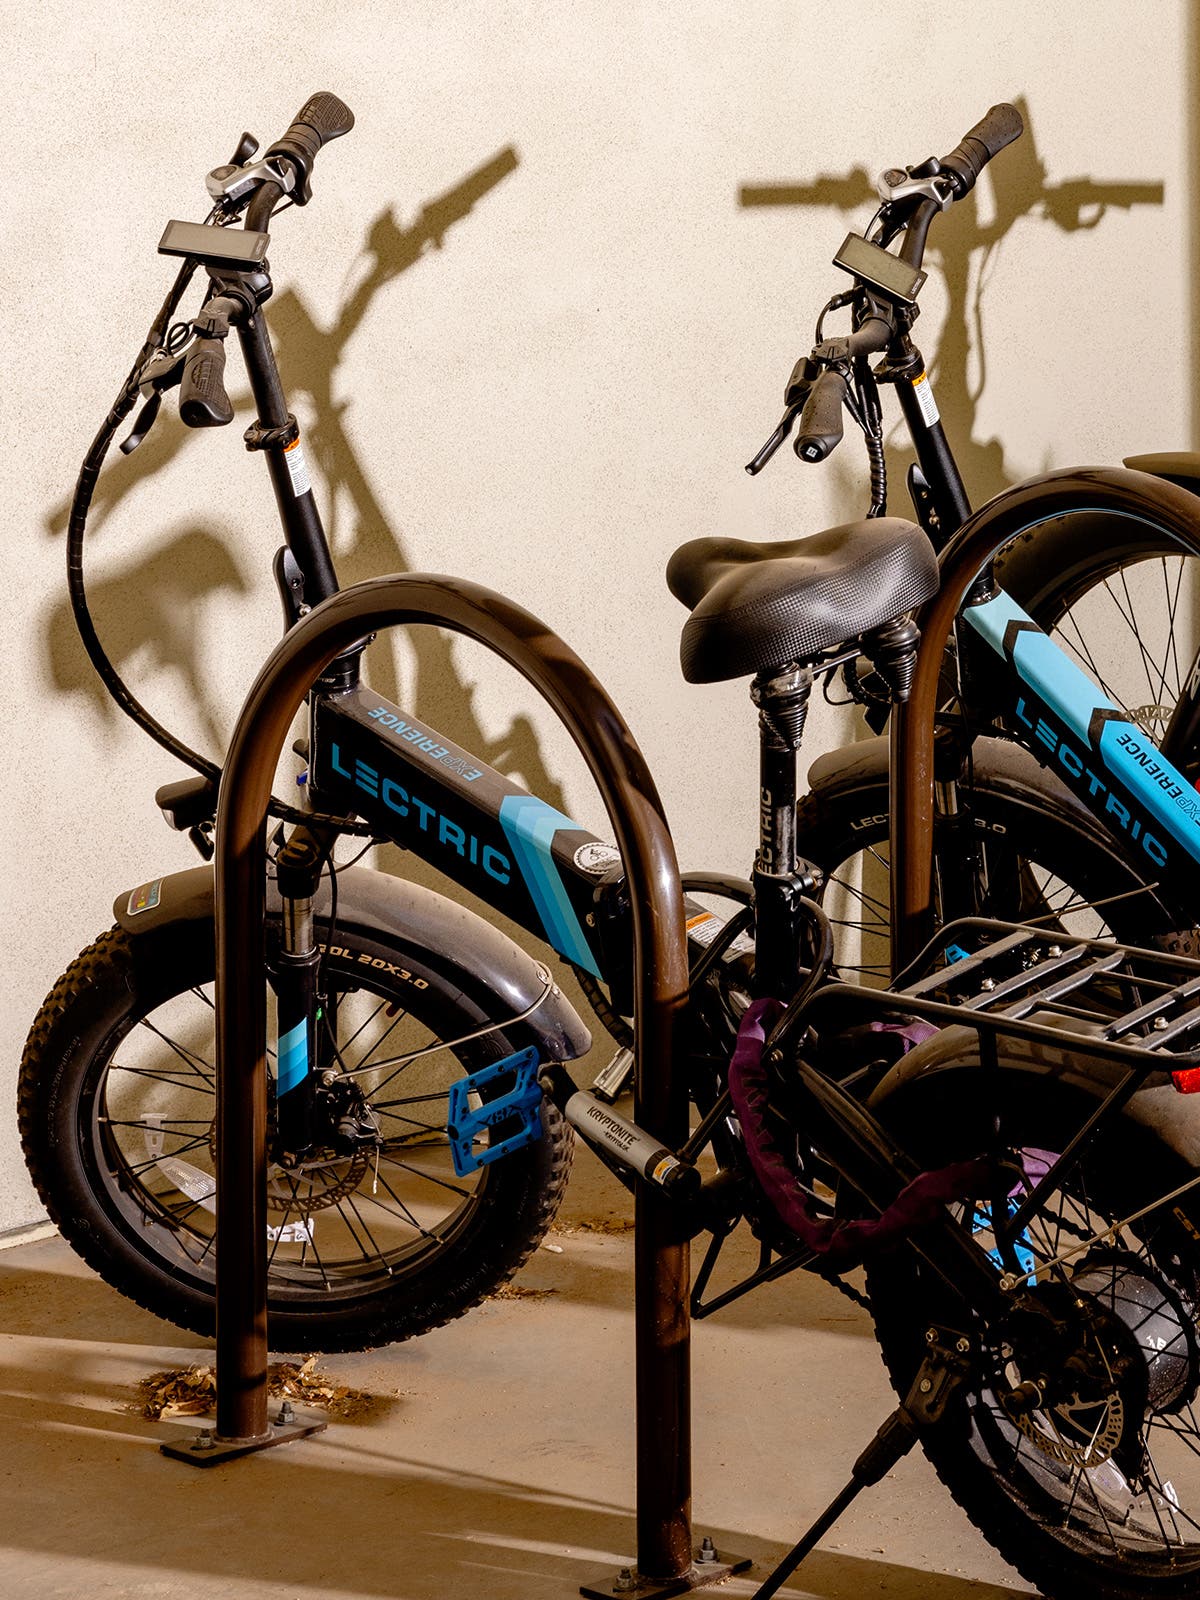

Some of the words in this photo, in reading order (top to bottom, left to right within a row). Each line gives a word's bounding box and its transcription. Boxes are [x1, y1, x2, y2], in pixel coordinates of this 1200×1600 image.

[366, 706, 484, 783] EXPERIENCE
[1015, 697, 1169, 868] LECTRIC
[331, 741, 512, 886] LECTRIC
[586, 1106, 638, 1146] KRYPTONITE
